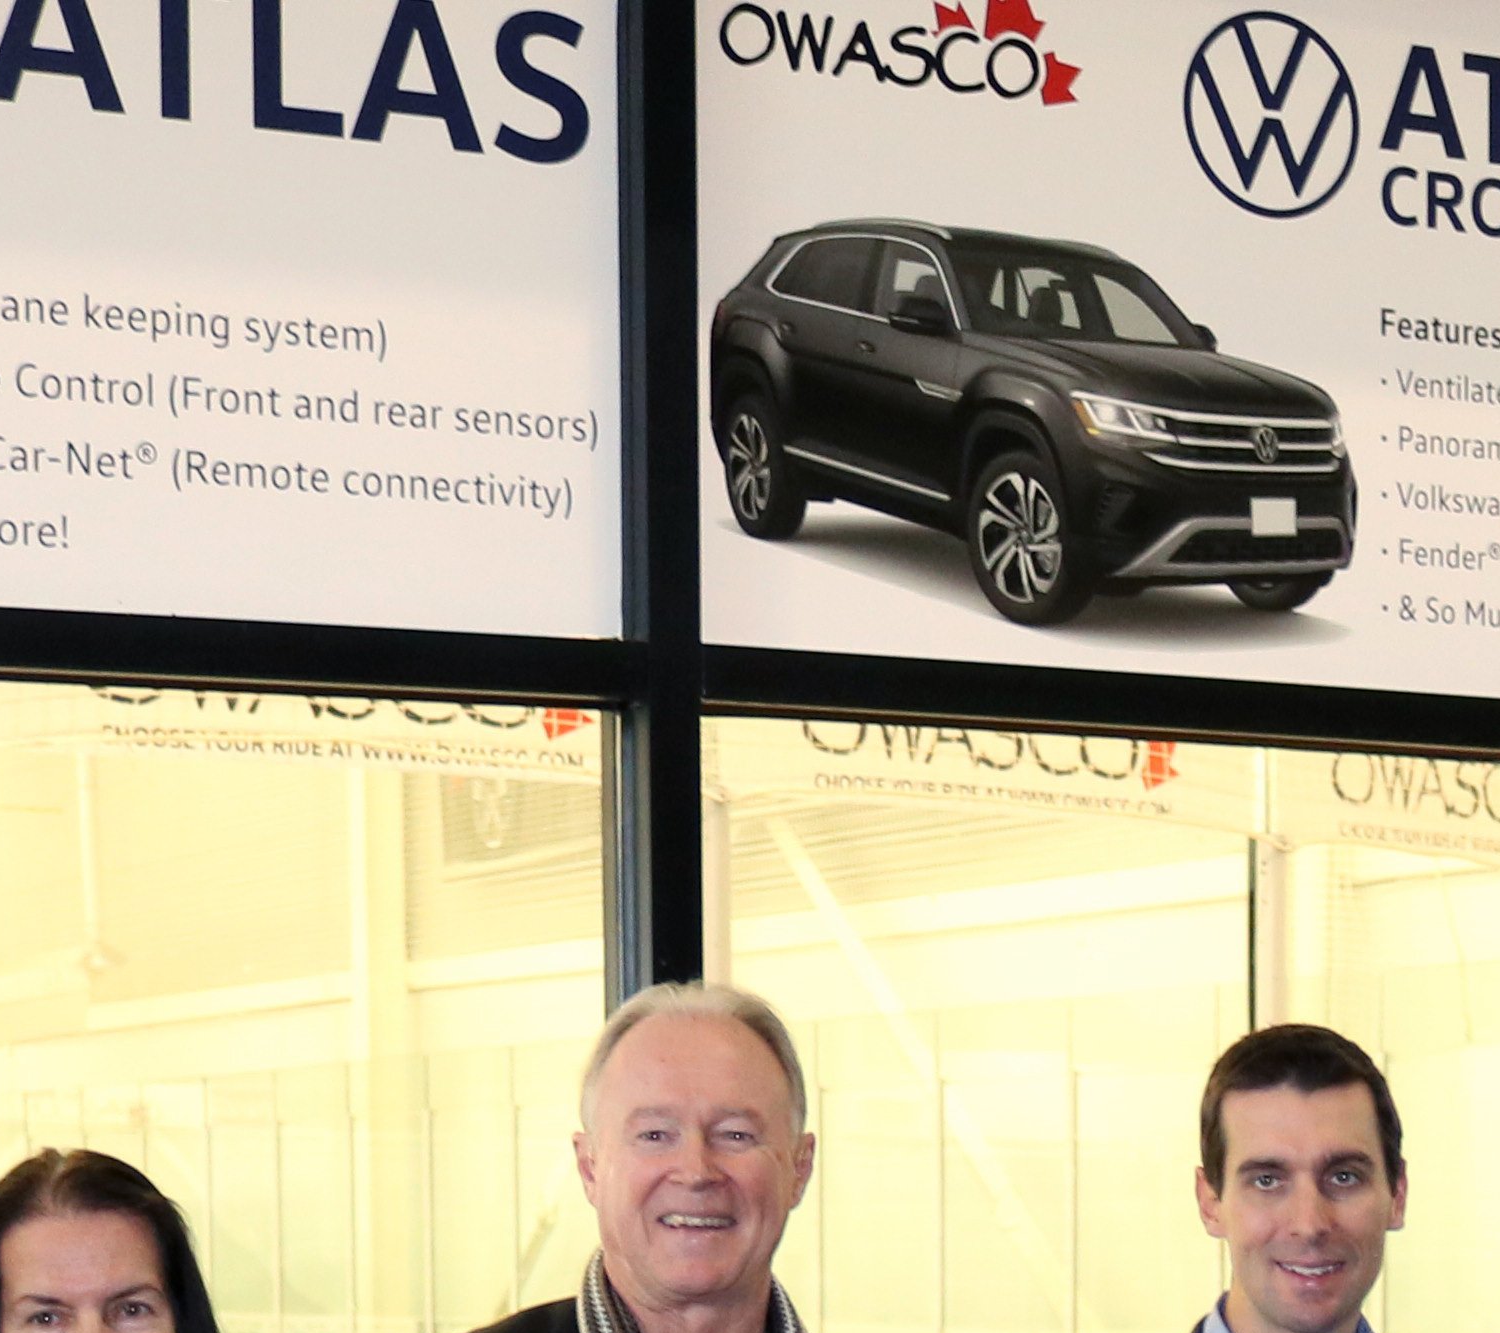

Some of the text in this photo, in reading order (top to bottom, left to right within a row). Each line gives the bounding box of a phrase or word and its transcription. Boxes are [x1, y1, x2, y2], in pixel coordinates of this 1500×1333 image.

[719, 2, 1039, 99] OWASCO
[84, 294, 229, 348] keeping
[245, 318, 386, 362] system)
[16, 363, 153, 406] Control
[169, 375, 280, 417] (Front
[294, 390, 358, 423] and
[375, 402, 442, 429] rear
[455, 408, 598, 452] sensors)
[173, 449, 329, 493] (Remote
[343, 471, 572, 519] connectivity)
[1400, 595, 1416, 621] &
[1426, 597, 1455, 624] So
